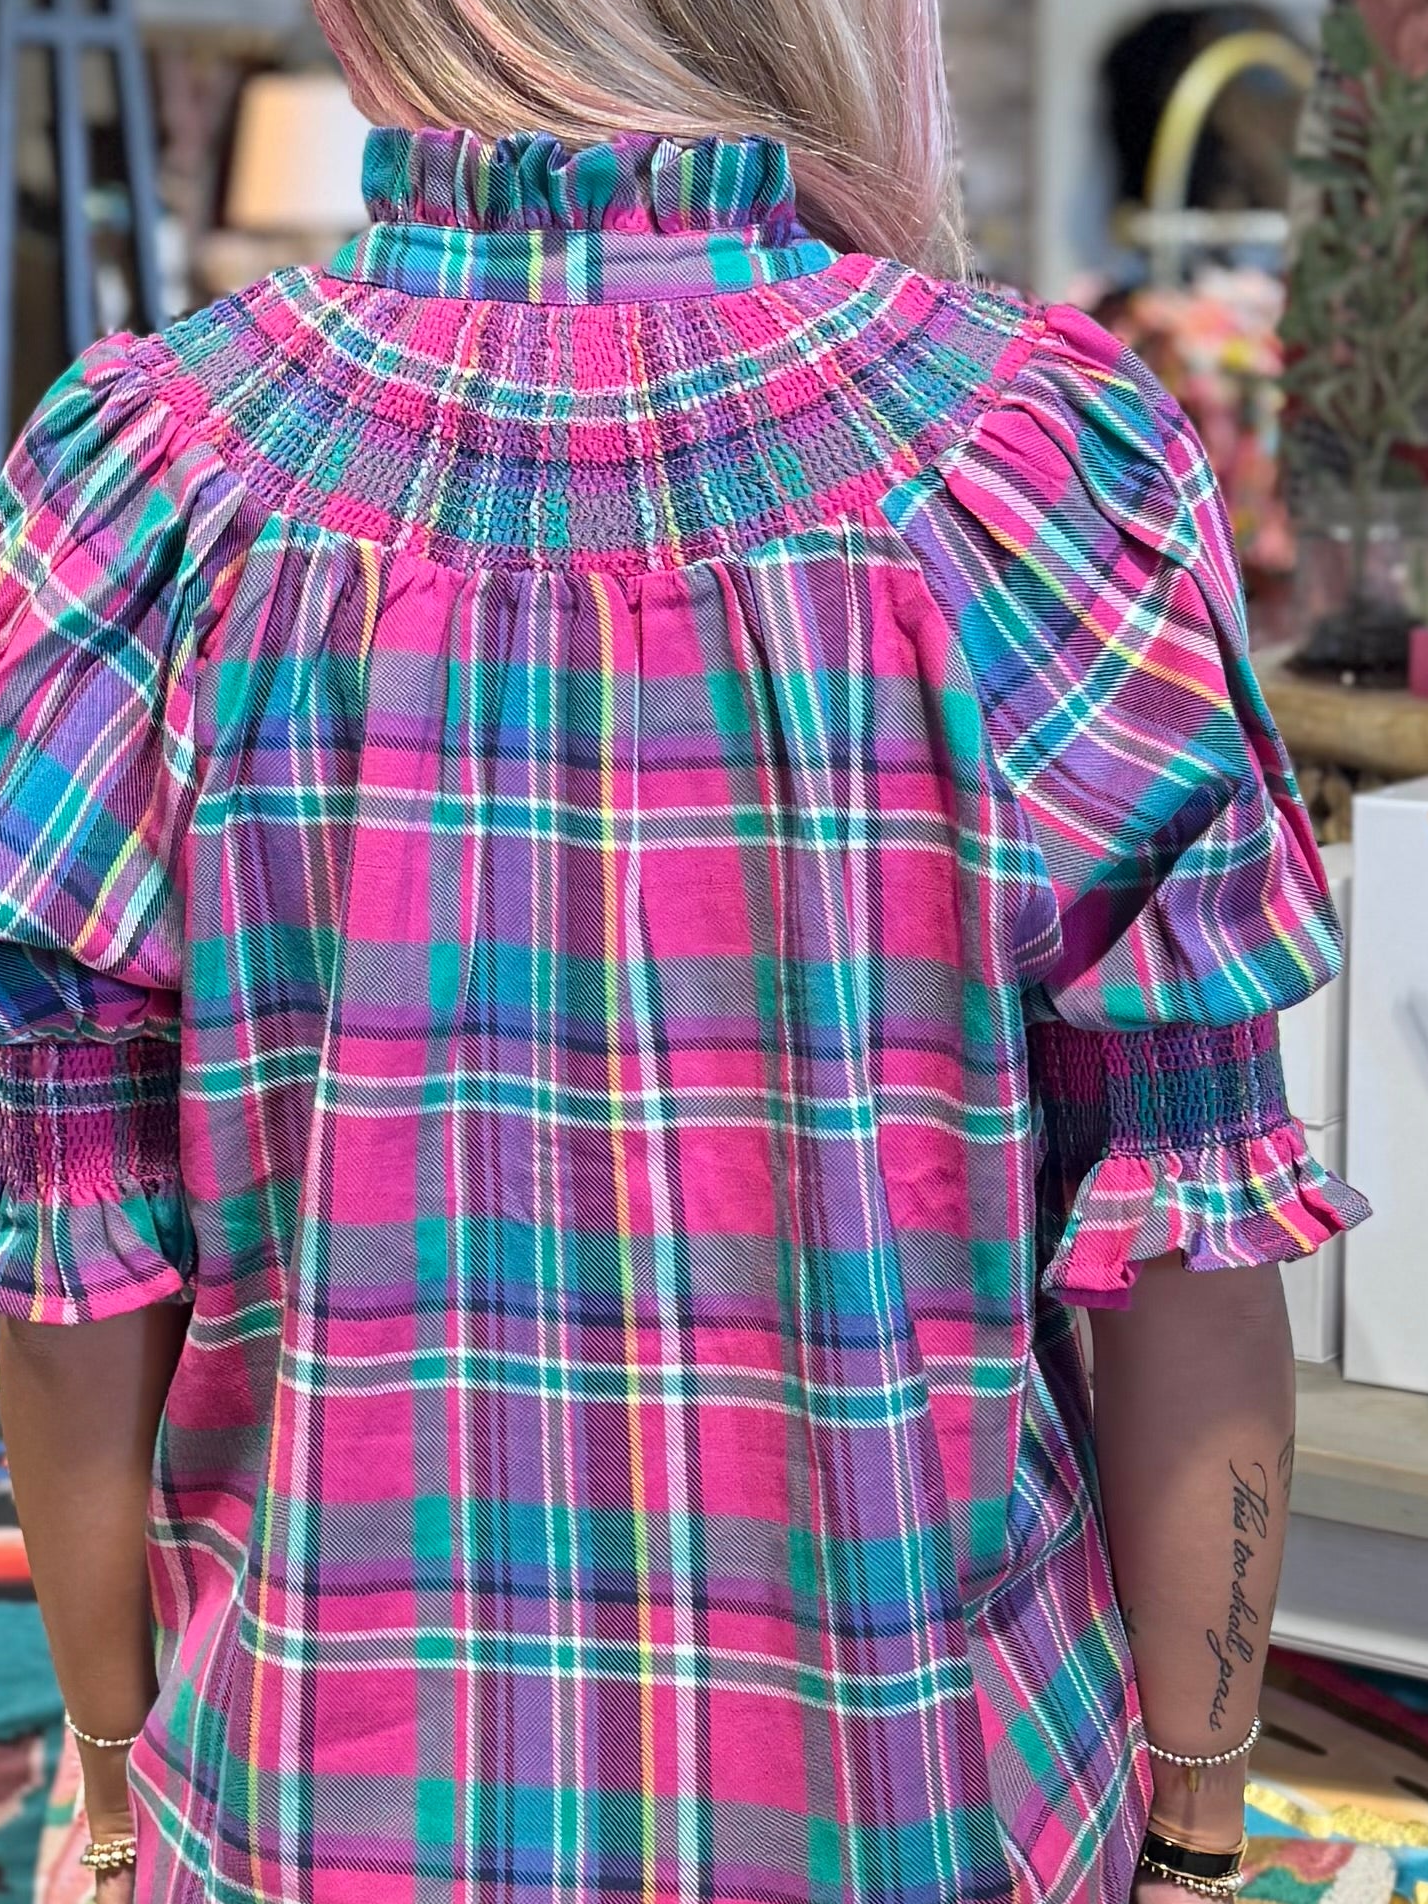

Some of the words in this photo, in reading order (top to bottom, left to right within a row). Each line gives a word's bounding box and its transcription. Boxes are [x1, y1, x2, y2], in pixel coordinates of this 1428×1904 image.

[1228, 1456, 1270, 1540] This
[1233, 1541, 1256, 1585] too
[1224, 1579, 1260, 1664] shall
[1205, 1628, 1235, 1733] pass
